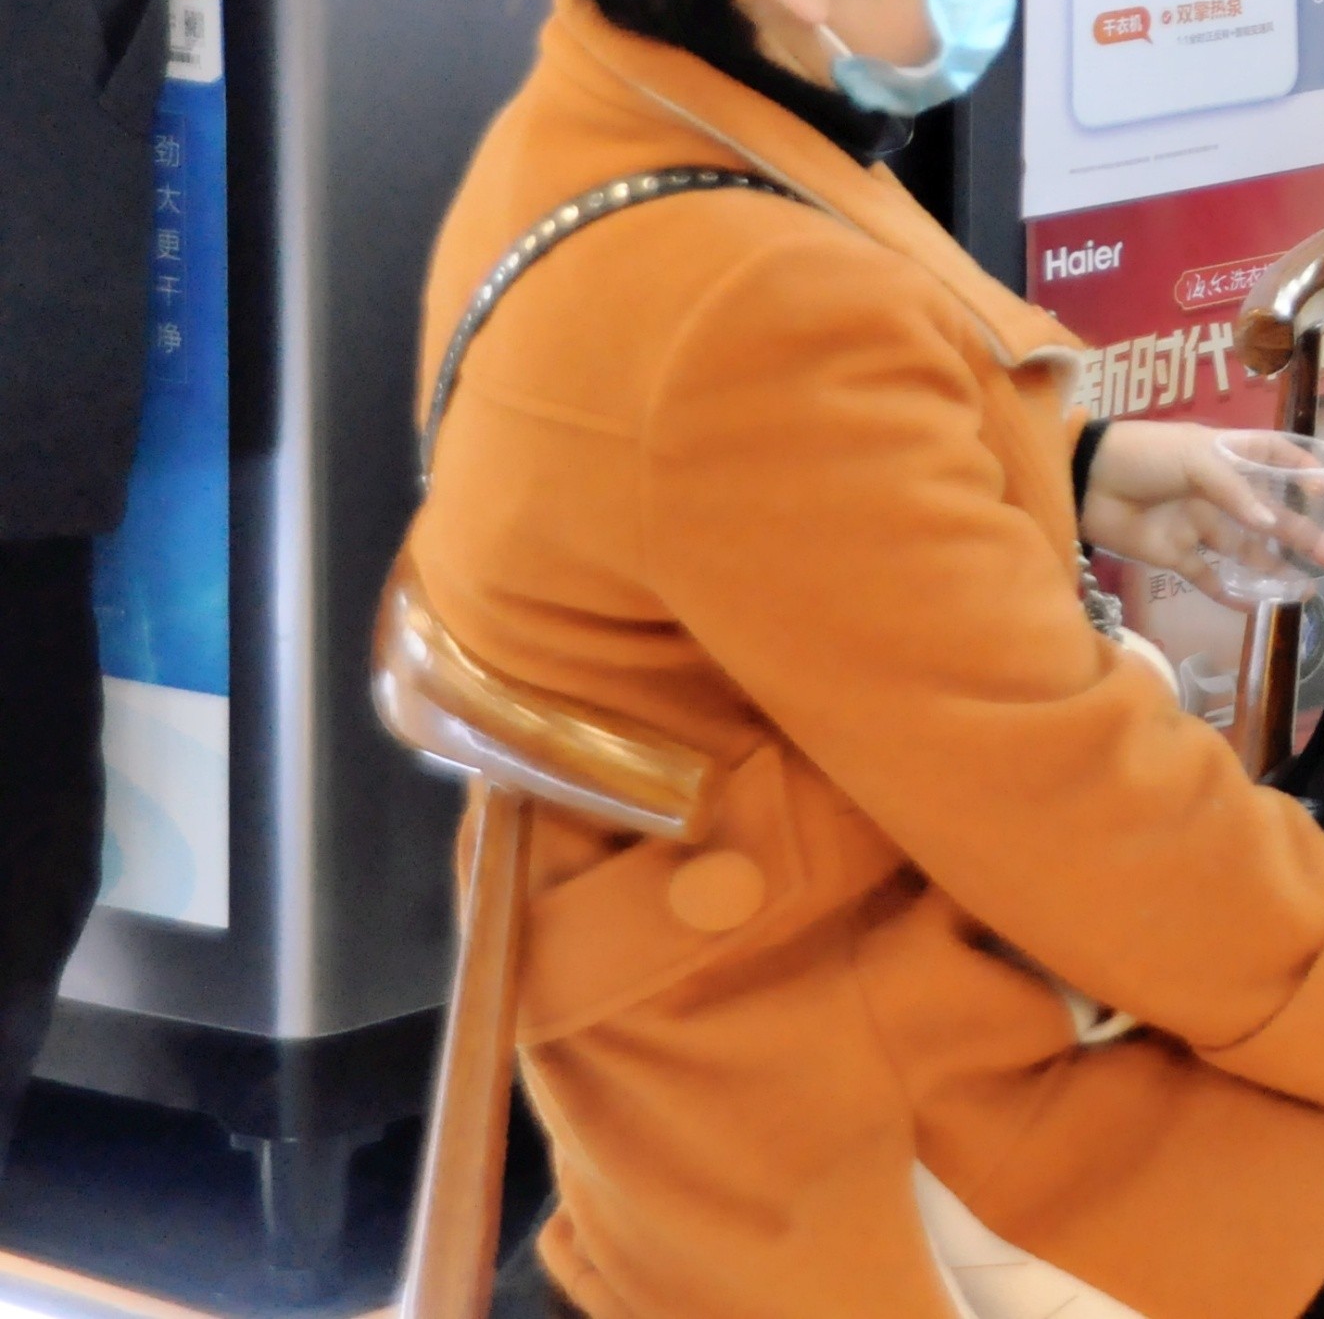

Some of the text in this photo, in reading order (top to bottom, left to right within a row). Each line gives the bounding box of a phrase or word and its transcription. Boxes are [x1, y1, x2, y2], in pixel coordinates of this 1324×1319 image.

[1102, 14, 1143, 37] 干衣机
[1043, 239, 1124, 281] Haier
[1185, 263, 1272, 302] 海尔洗衣
